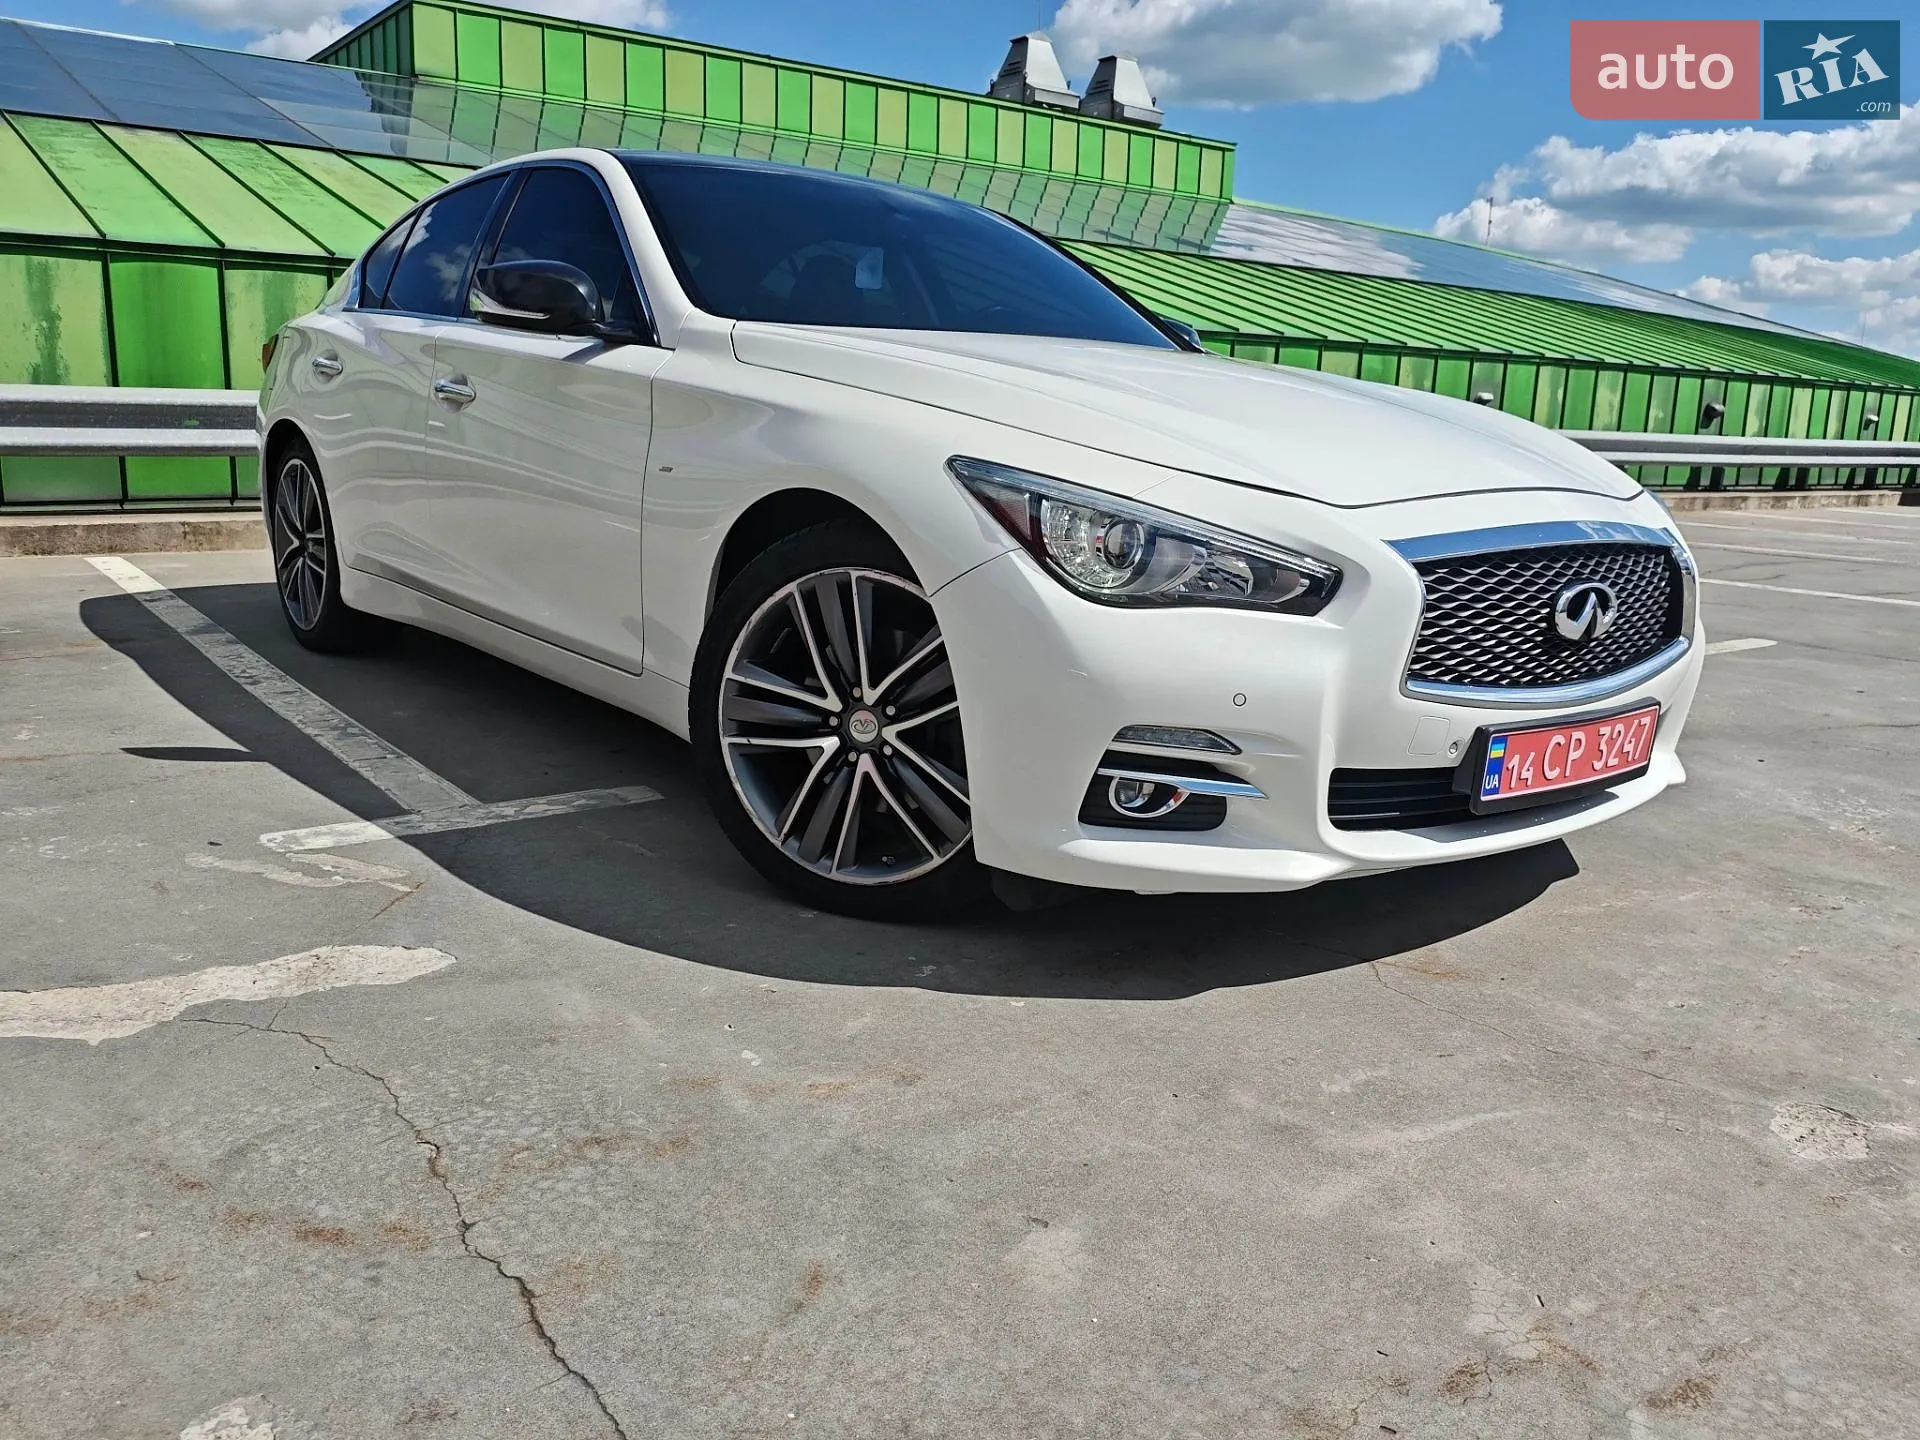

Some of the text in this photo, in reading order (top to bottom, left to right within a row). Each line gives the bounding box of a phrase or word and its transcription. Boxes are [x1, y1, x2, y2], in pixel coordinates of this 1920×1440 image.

[1506, 715, 1651, 789] 14 CP 3247
[1485, 773, 1499, 790] UA
